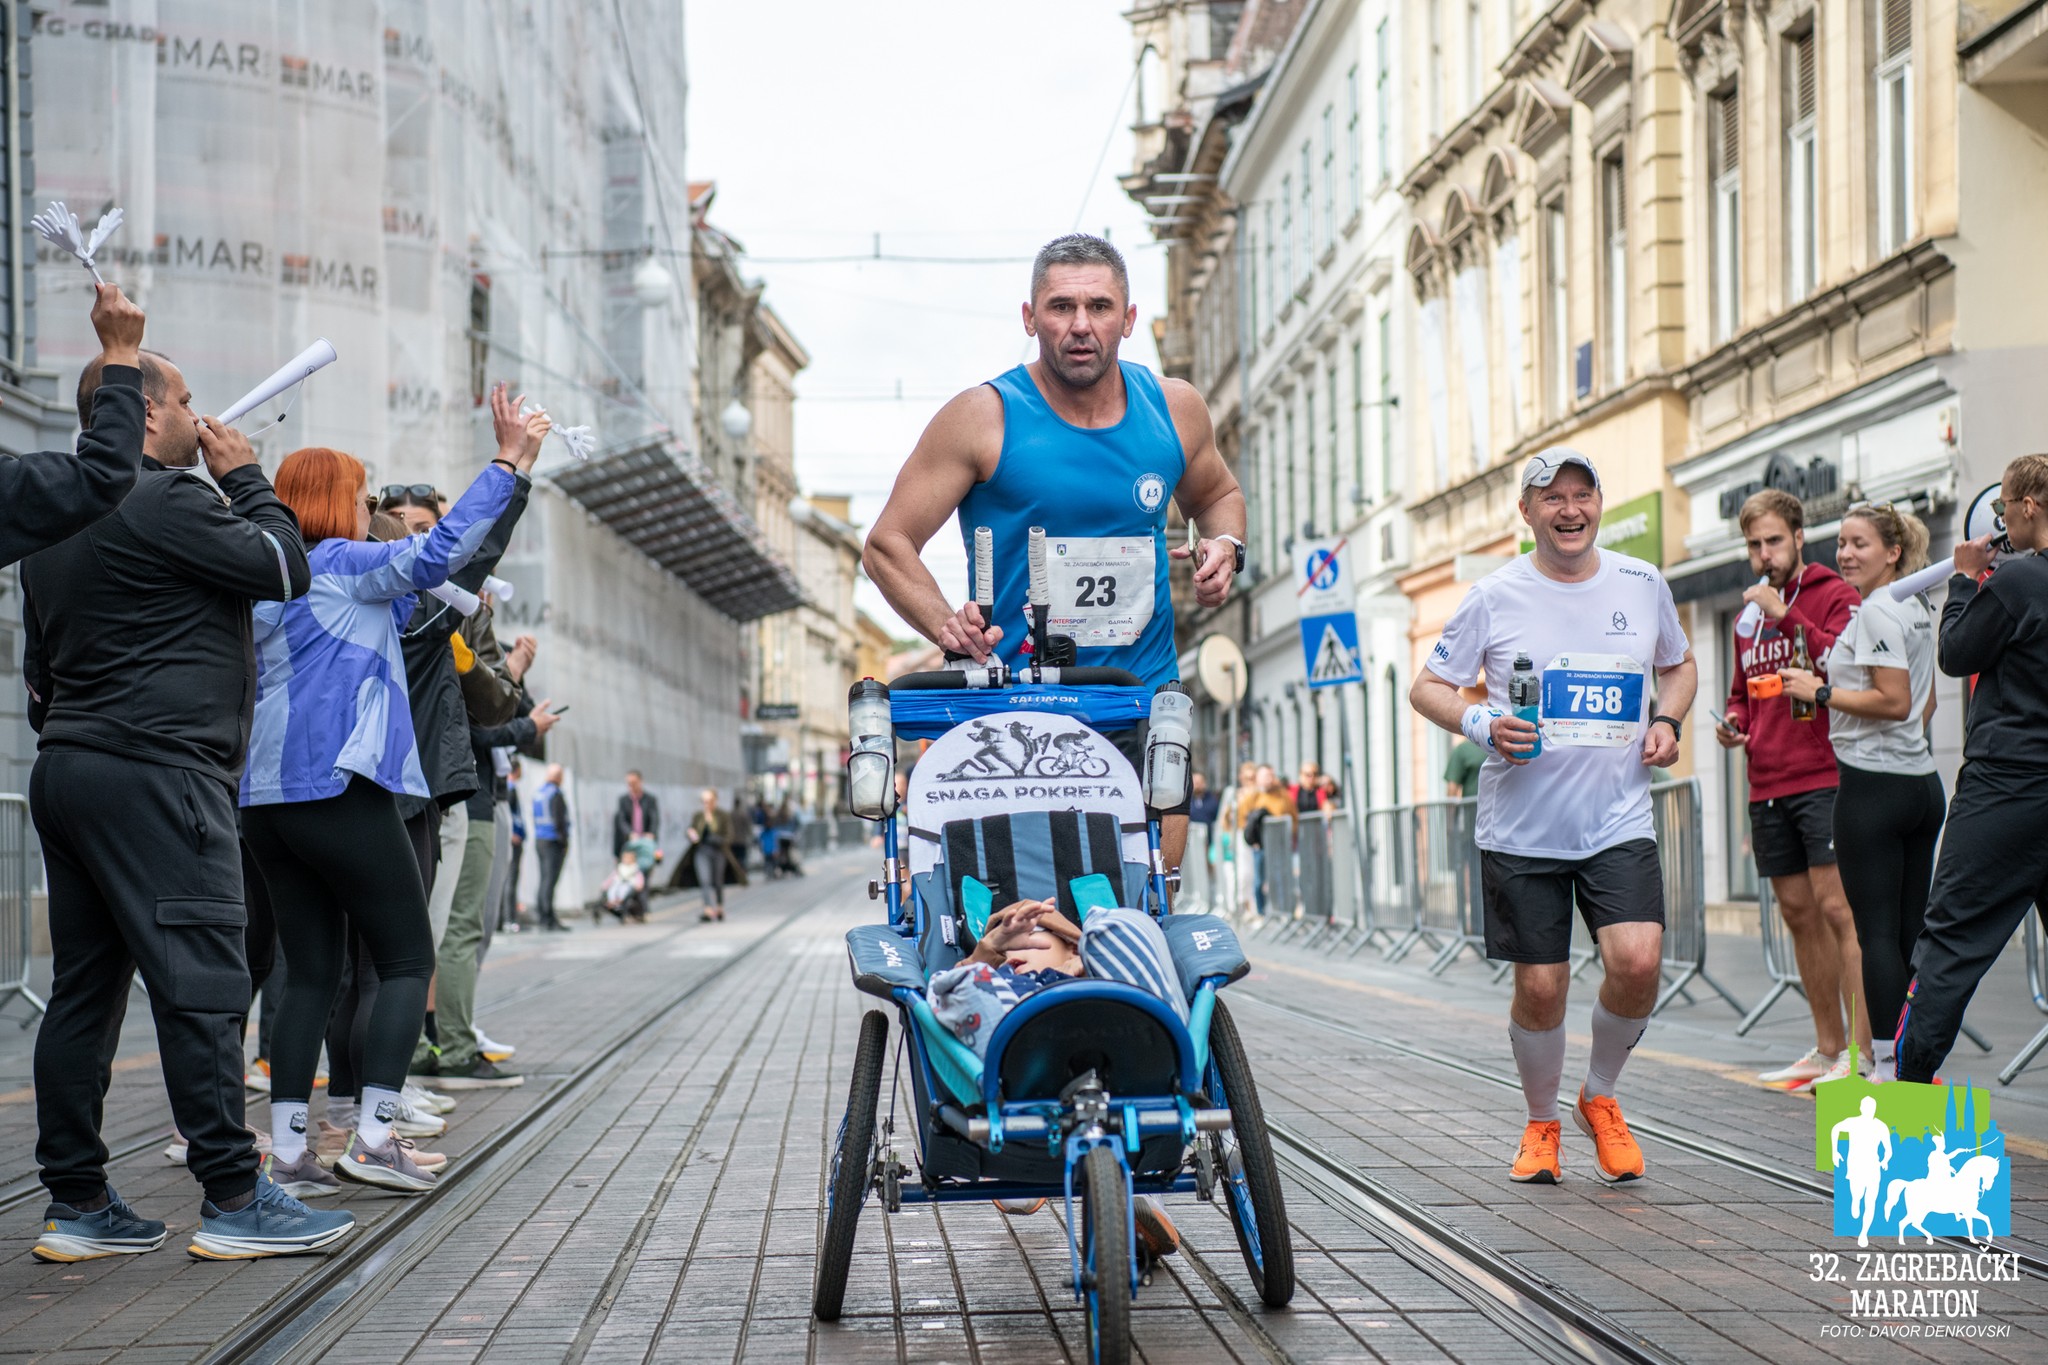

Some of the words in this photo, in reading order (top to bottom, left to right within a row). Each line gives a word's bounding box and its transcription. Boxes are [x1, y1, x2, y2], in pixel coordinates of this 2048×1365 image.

[174, 36, 261, 77] MAR
[313, 61, 375, 99] MAR
[177, 236, 264, 277] MAR
[316, 260, 378, 298] MAR
[1619, 568, 1649, 578] CRAFT
[1075, 576, 1117, 608] 23
[1567, 684, 1623, 715] 758
[926, 786, 1008, 804] SNAGA
[1014, 785, 1125, 800] POKRETA
